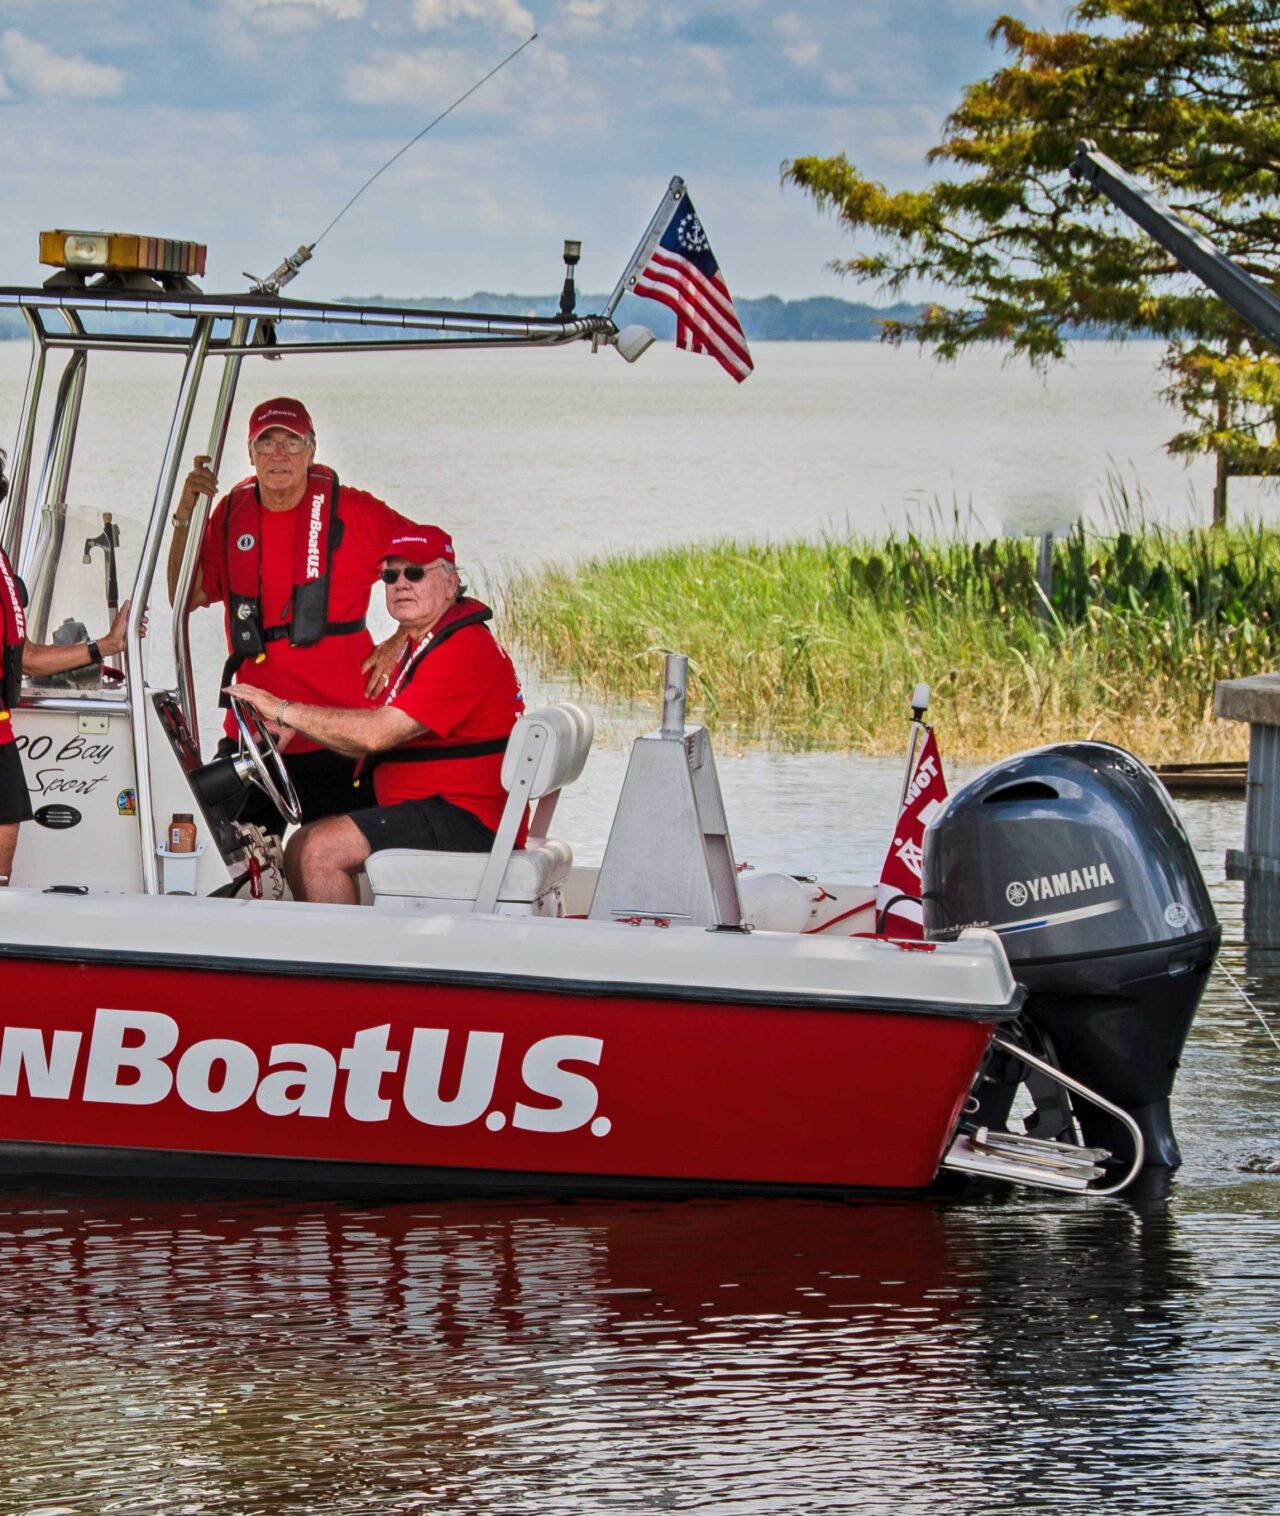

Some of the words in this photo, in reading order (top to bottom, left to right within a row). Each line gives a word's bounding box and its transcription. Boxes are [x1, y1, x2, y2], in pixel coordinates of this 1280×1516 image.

[55, 735, 114, 765] Bay
[28, 768, 110, 797] Sport
[1026, 862, 1115, 901] YAMAHA
